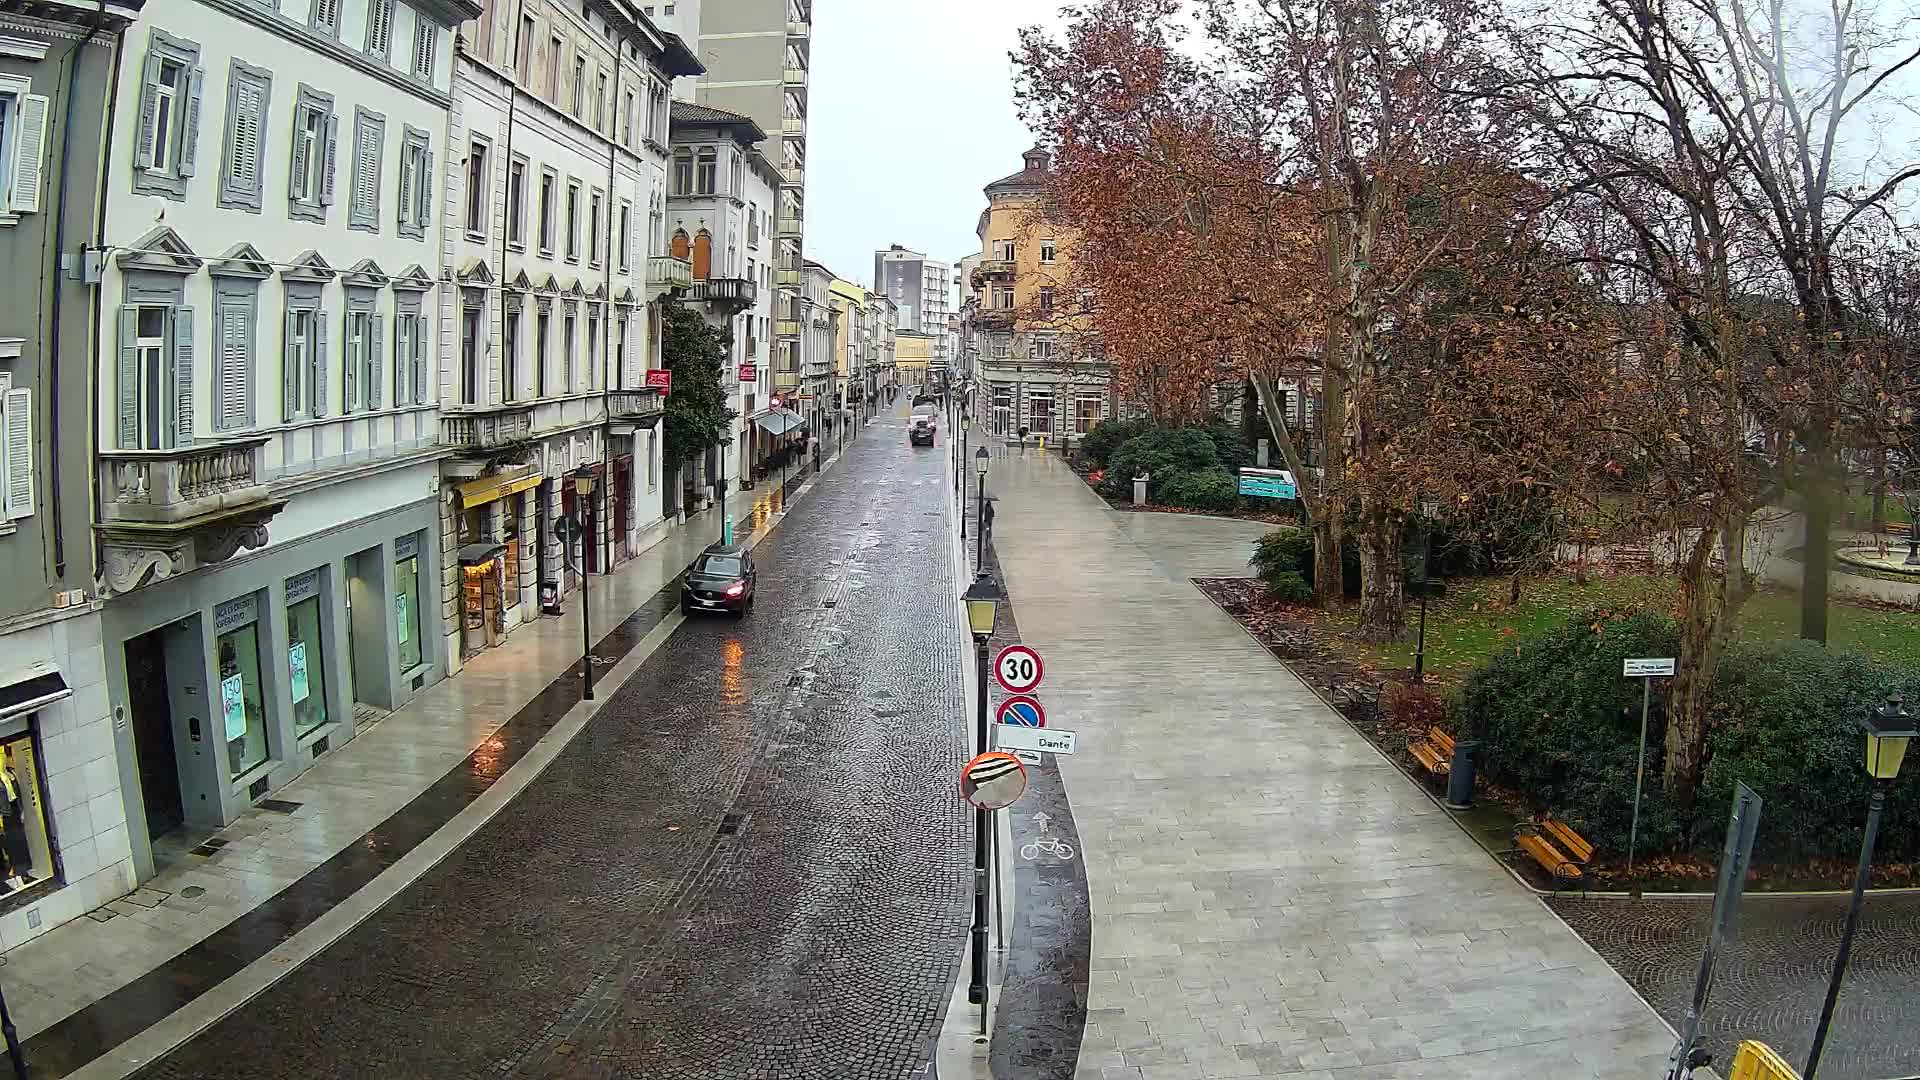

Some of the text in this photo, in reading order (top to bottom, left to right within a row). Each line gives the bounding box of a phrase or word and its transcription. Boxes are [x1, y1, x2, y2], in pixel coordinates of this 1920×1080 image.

[1006, 658, 1033, 681] 30
[222, 678, 241, 700] 130
[1039, 738, 1070, 750] Dante
